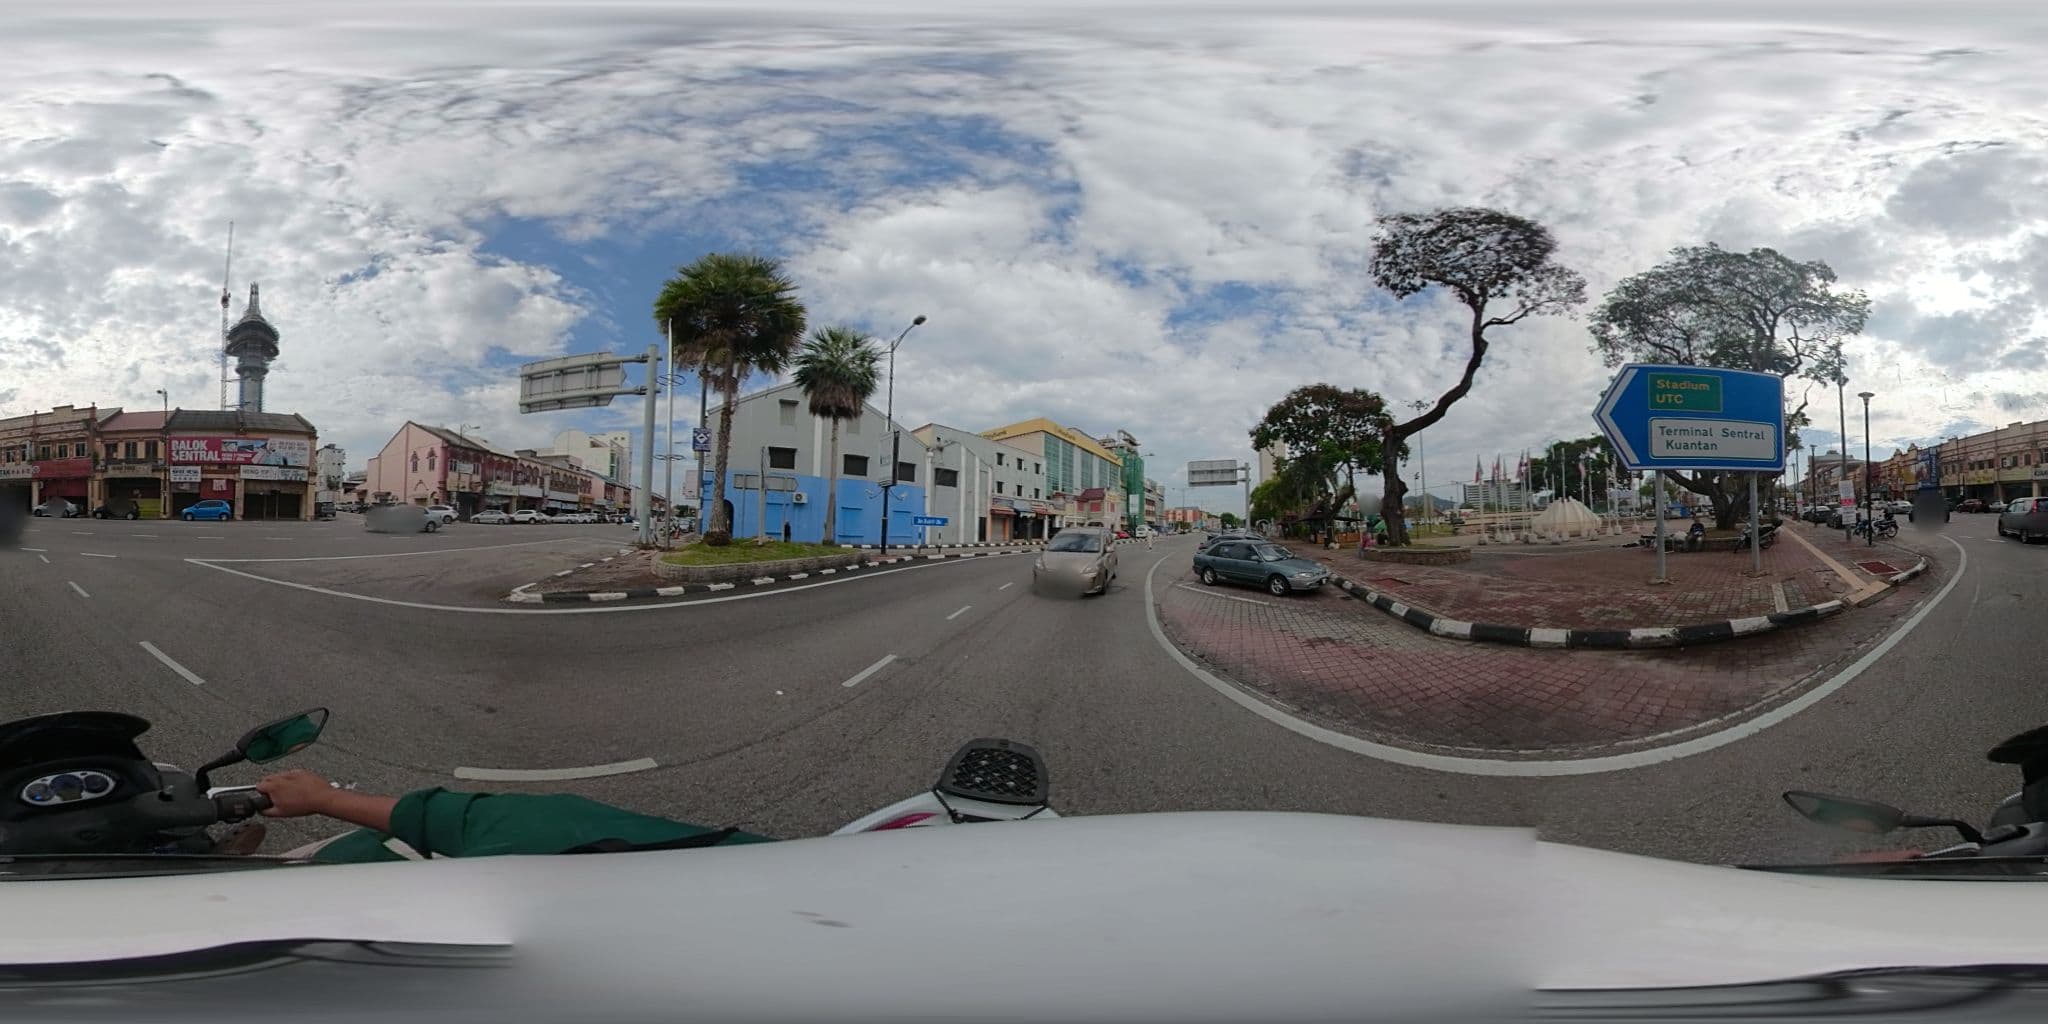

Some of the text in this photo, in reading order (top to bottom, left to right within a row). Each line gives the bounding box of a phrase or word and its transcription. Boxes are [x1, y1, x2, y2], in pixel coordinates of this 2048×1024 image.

[1657, 380, 1710, 391] Stadium
[1656, 394, 1684, 404] UTC
[1659, 426, 1765, 440] Terminal Sentral
[171, 440, 207, 450] BALOK
[1666, 440, 1718, 450] Kuantan
[171, 450, 220, 461] SENTRAL
